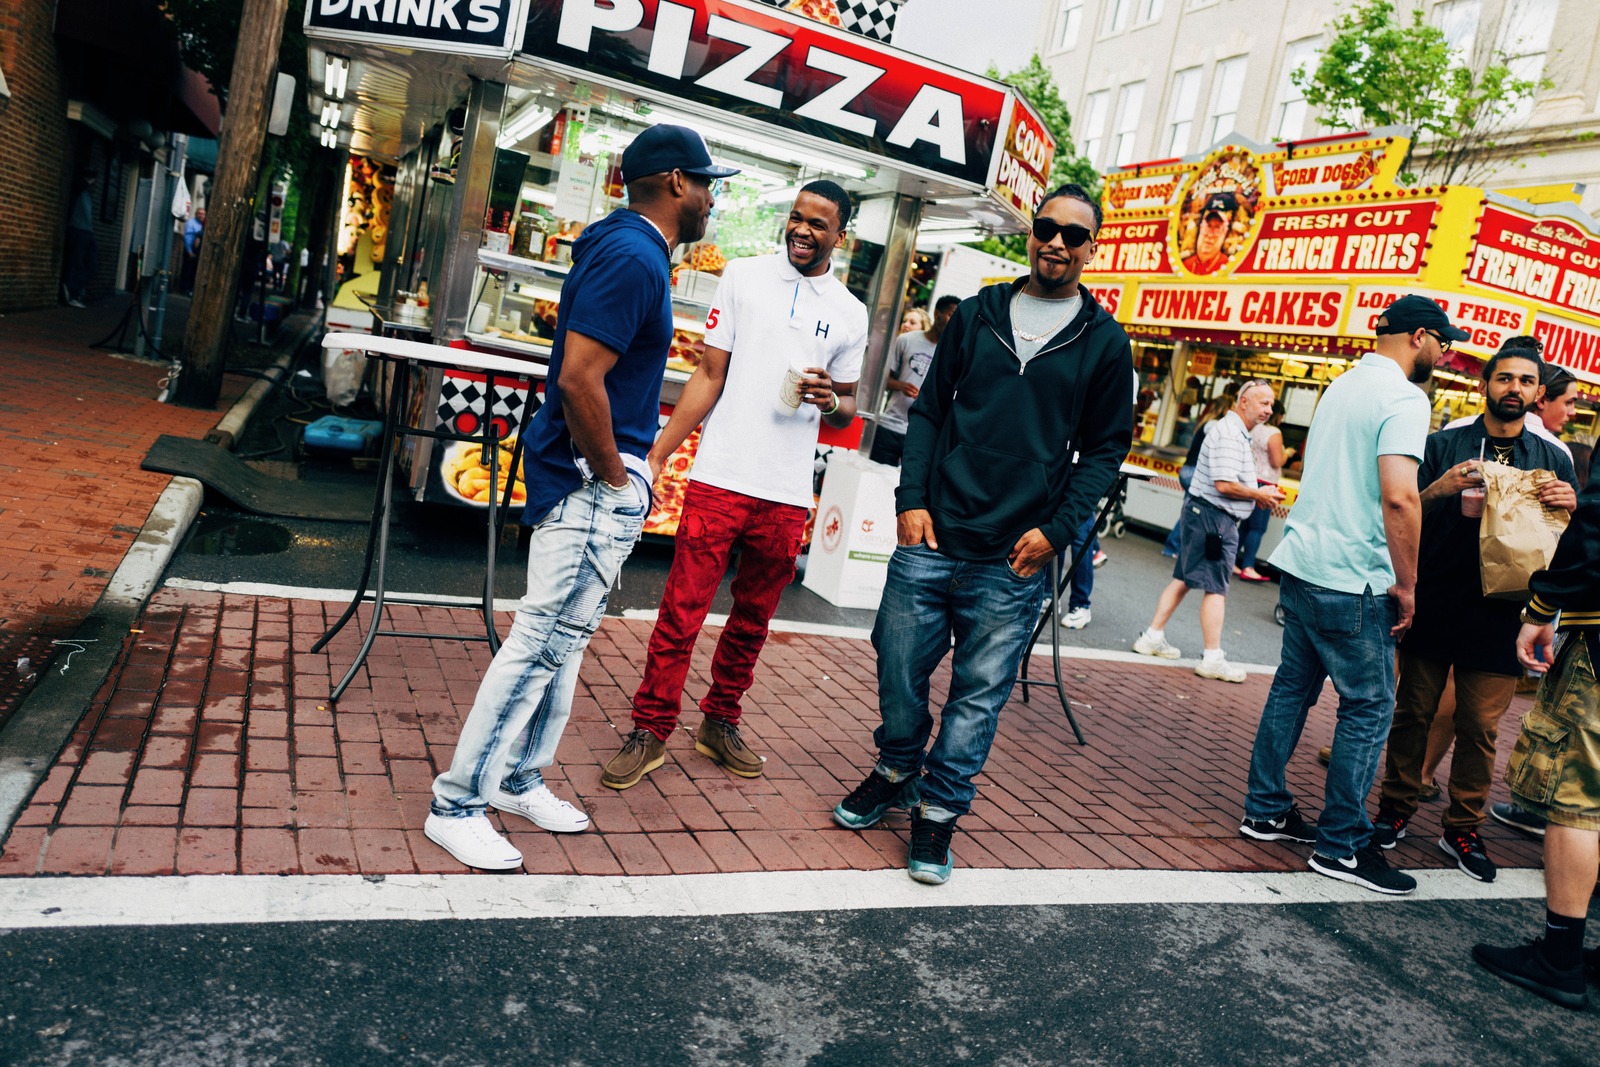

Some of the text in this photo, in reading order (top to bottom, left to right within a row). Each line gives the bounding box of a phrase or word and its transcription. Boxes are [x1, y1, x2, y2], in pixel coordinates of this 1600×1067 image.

[556, 0, 966, 165] PIZZA
[1015, 121, 1045, 173] COLD
[999, 150, 1045, 214] DRINKS
[1280, 162, 1363, 187] CORN DOGS
[1145, 183, 1172, 199] DOGS
[1124, 224, 1159, 239] CUT
[1272, 210, 1412, 231] FRESH CUT
[1116, 242, 1164, 271] FRIES
[1252, 233, 1421, 270] FRENCH FRIES
[1499, 229, 1600, 270] FRESH CU
[1469, 244, 1560, 300] FRENCH
[705, 308, 721, 330] 5
[1138, 289, 1232, 322] FUNNEL
[1240, 291, 1342, 328] CAKES
[1456, 302, 1522, 330] FRIES
[815, 320, 830, 339] H
[1123, 324, 1172, 336] DOGS
[1240, 333, 1329, 347] FRENCH
[1533, 319, 1600, 375] FUNNE
